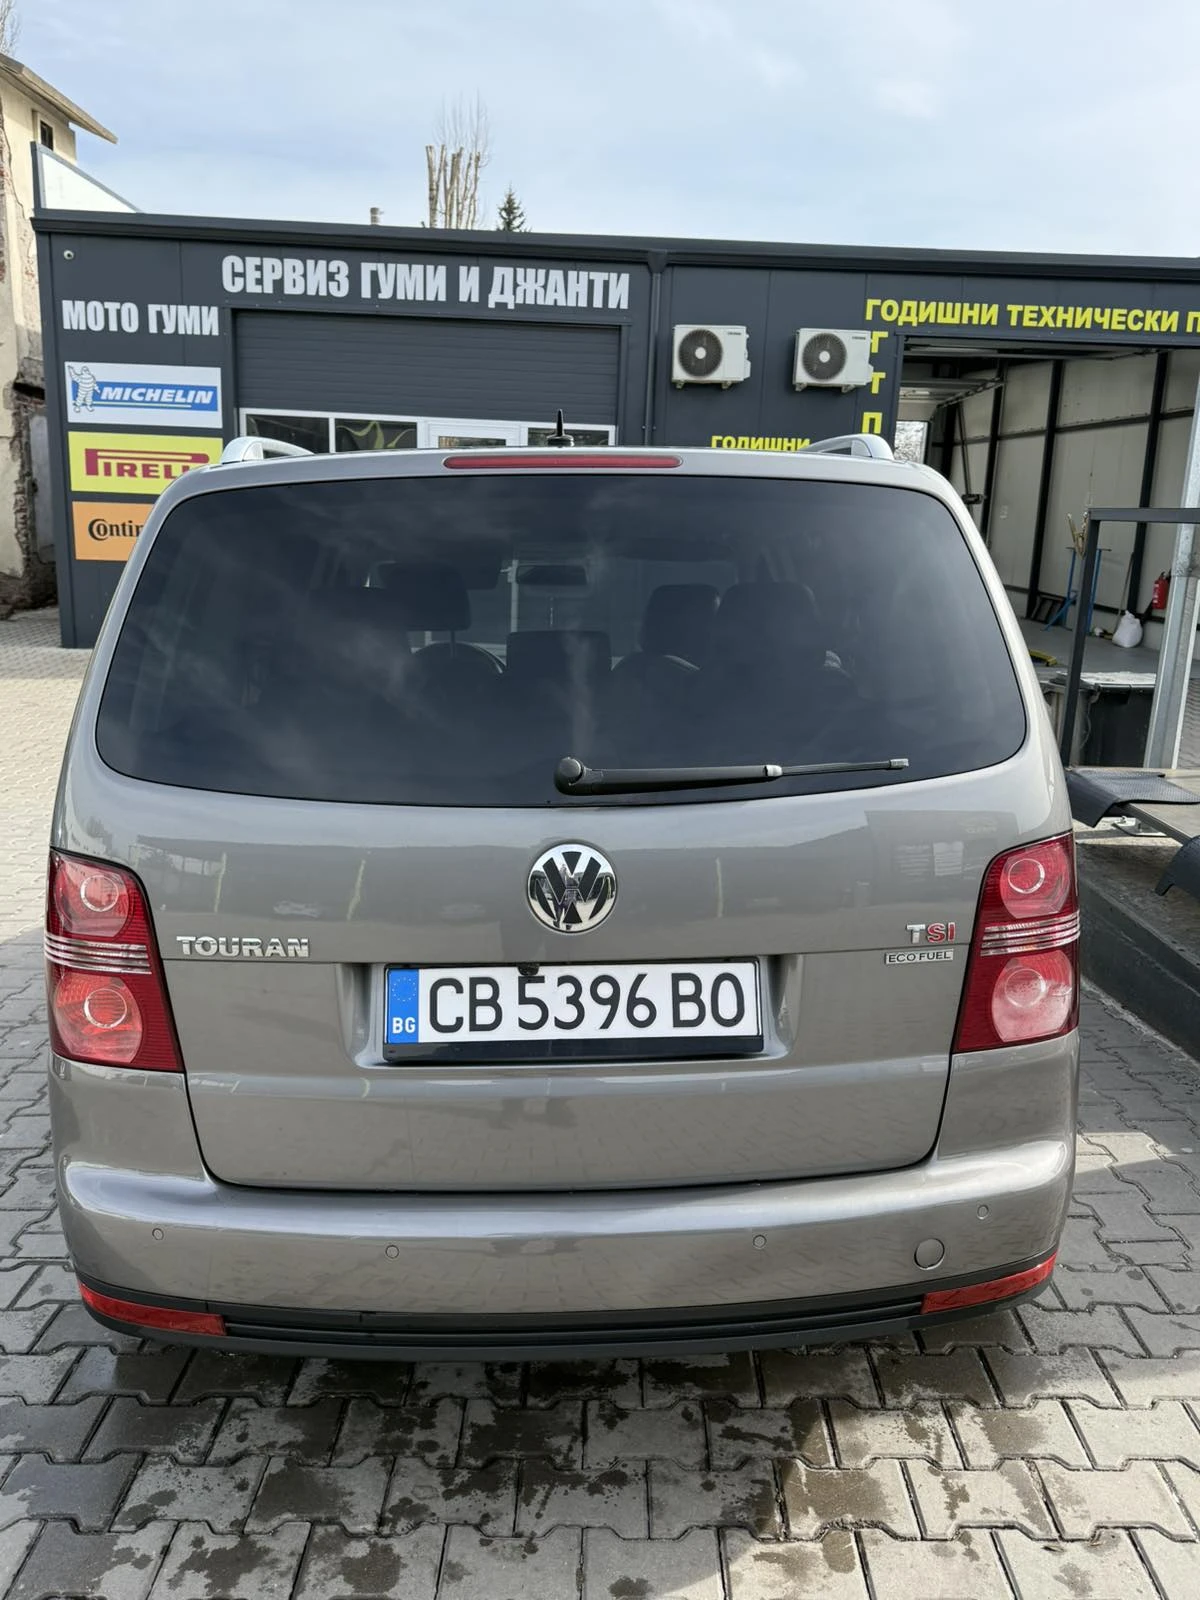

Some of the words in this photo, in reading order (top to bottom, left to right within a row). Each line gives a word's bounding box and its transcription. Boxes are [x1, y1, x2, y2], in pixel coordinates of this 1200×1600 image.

[222, 255, 350, 298] СЕРВИЗ
[360, 262, 447, 302] ГУМИ
[459, 265, 480, 303] И
[488, 266, 630, 310] ДЖАНТИ
[62, 300, 140, 333] МОТО
[147, 304, 220, 336] ГУМИ
[865, 298, 999, 327] ГОДИШНИ
[1006, 304, 1180, 333] ТЕХНИЧЕСКИ
[100, 387, 214, 404] MICHELIN
[176, 936, 309, 957] TOURAN
[905, 922, 956, 944] TSI
[429, 976, 503, 1033] CB
[517, 974, 657, 1031] 5396
[392, 1017, 416, 1034] BG
